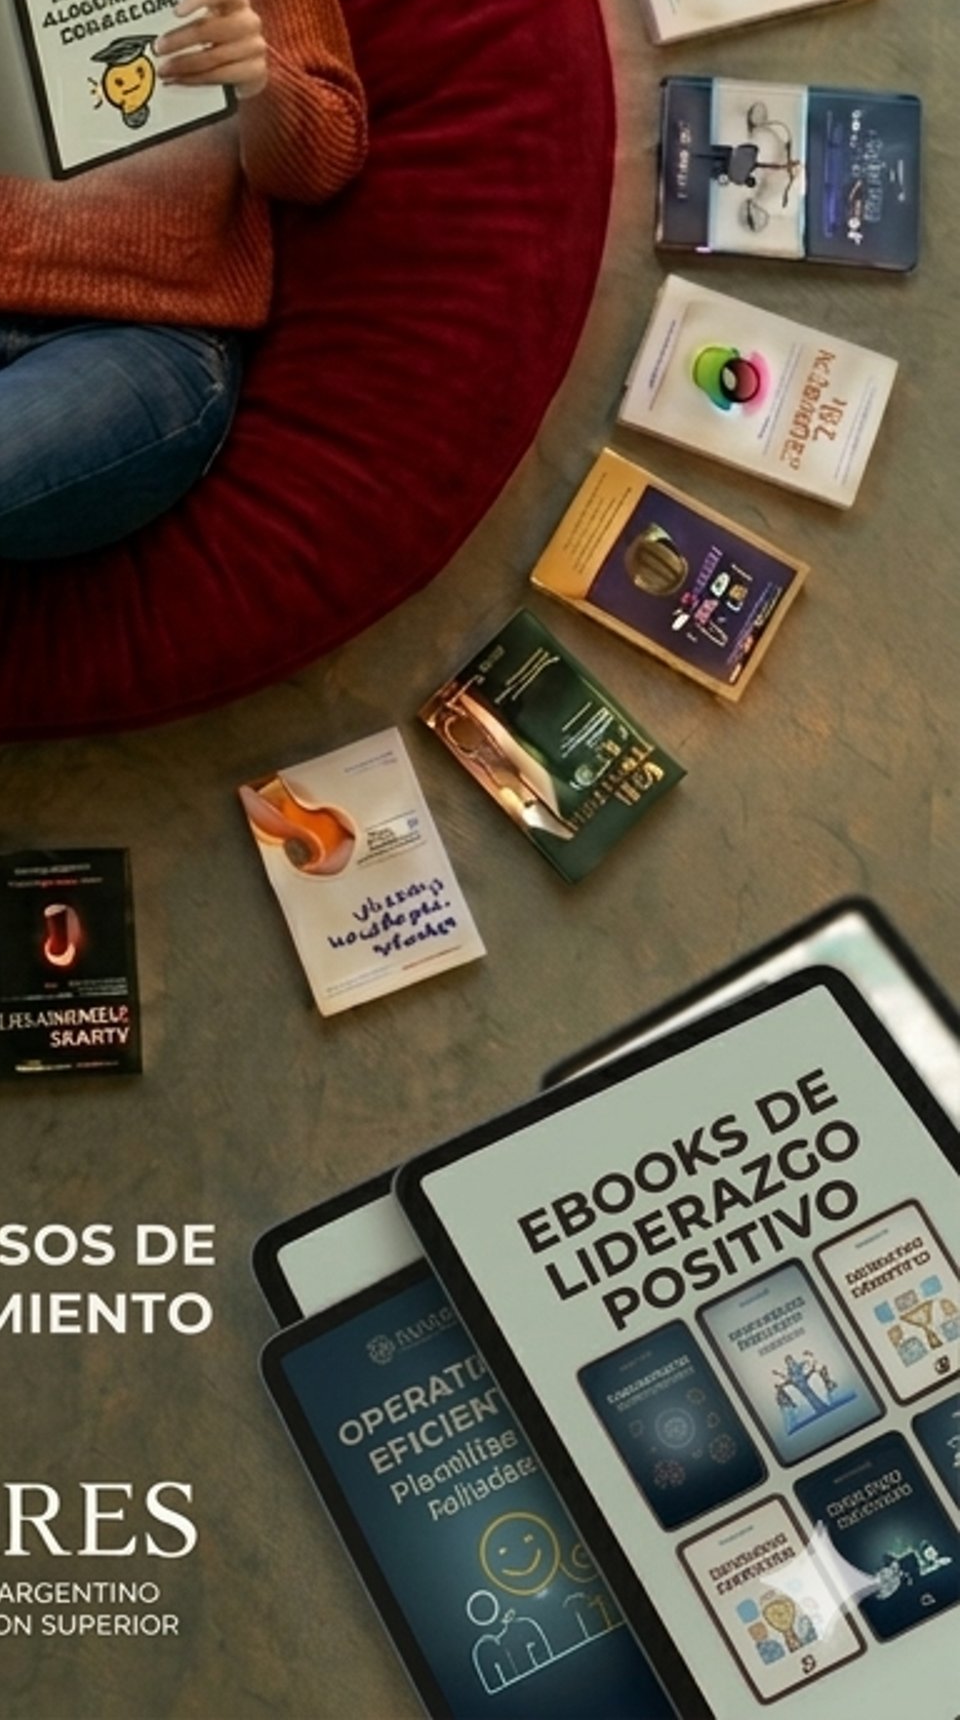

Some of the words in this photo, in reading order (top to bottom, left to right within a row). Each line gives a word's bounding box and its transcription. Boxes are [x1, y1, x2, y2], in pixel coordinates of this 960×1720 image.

[517, 1114, 749, 1254] EBOOKS
[755, 1068, 839, 1135] DE
[544, 1120, 860, 1301] LIDERAZGO
[601, 1179, 858, 1331] POSITIVO
